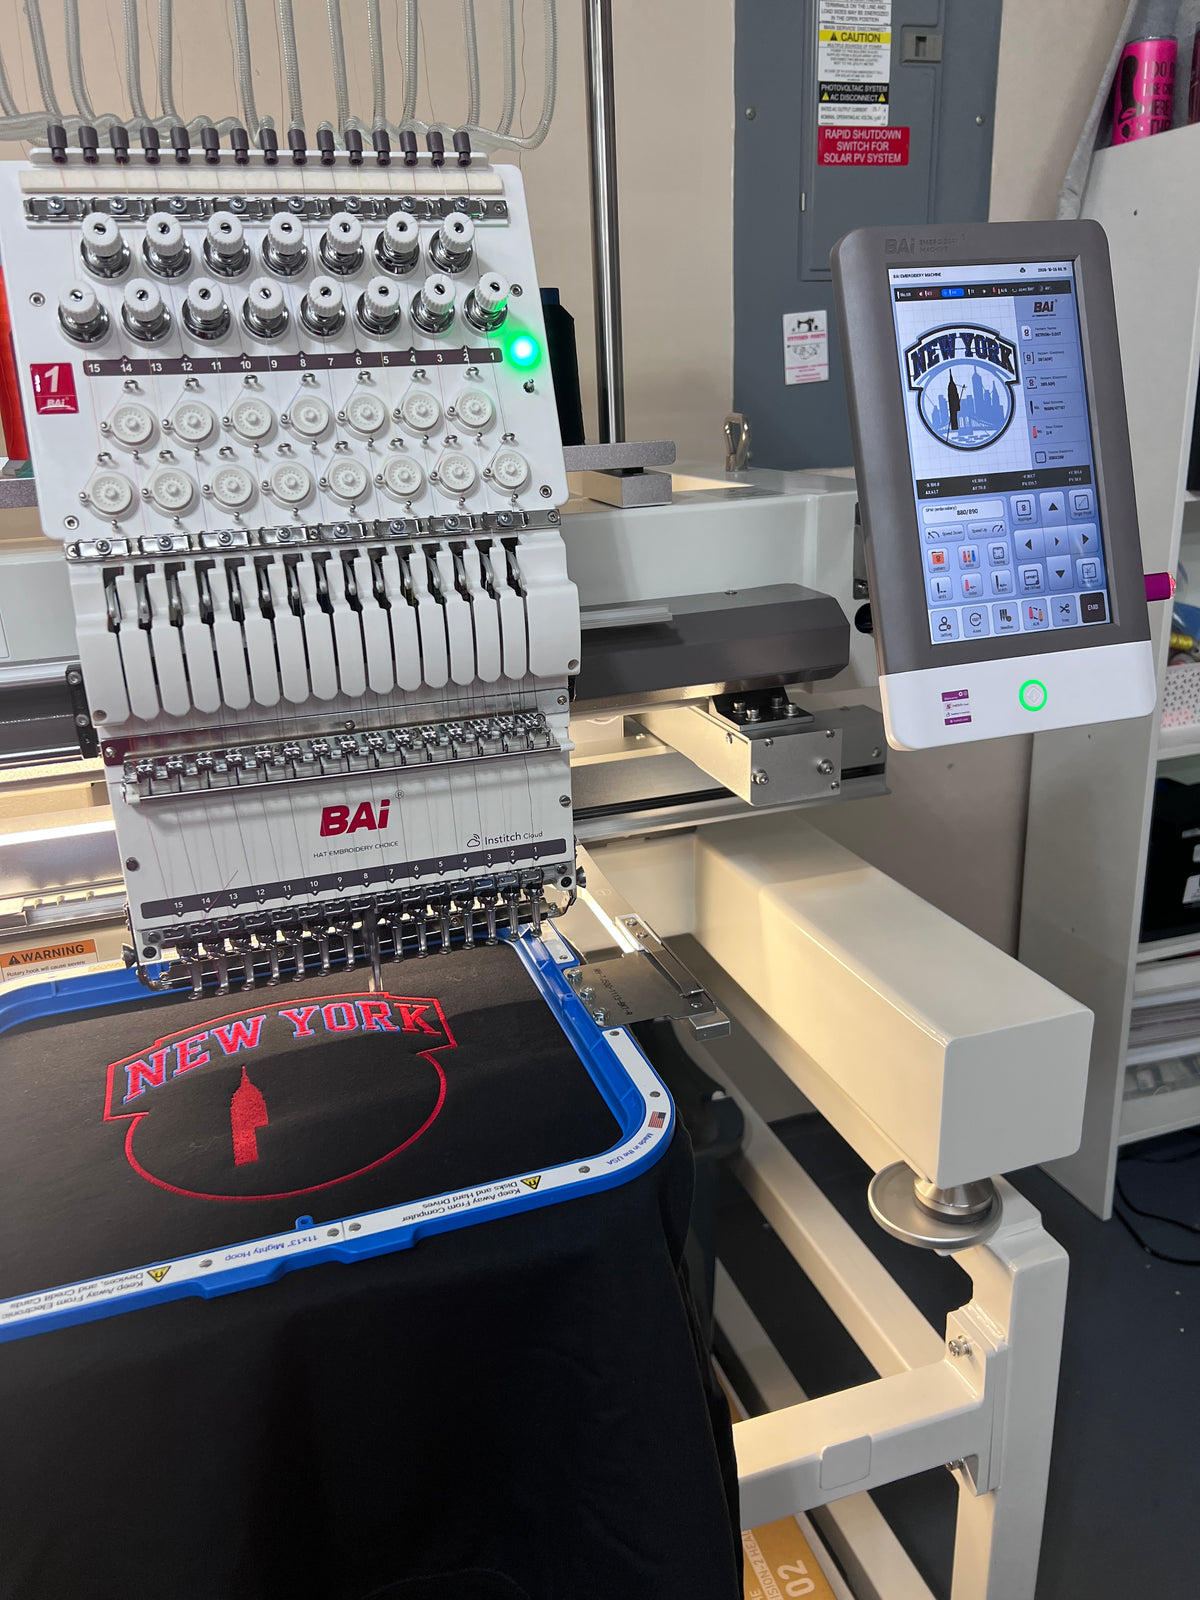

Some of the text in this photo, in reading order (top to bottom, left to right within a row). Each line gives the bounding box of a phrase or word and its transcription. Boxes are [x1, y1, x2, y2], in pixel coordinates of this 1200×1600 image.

[840, 32, 881, 43] CAUTION
[821, 84, 864, 92] PHOTOVOLTAIC
[840, 94, 878, 102] DISCONNECT
[825, 129, 902, 139] RAPID SHUTDOWN
[836, 141, 889, 151] SWITCH FOR
[823, 153, 901, 163] SOLAR PV SYSTEM
[1034, 301, 1054, 313] BAi
[88, 352, 495, 373] 15 14 13 12 11 10 9 8 7 6 5 4 3 2 1
[910, 332, 1015, 382] NEW YORK
[44, 365, 59, 393] 1
[956, 508, 979, 516] 880/890
[1087, 603, 1099, 611] EMB
[319, 799, 391, 837] BAi
[484, 831, 543, 846] Institch Cloud
[313, 840, 399, 859] HAT EMBROIDERY CHOICE
[174, 901, 183, 909] 15
[201, 897, 211, 905] 14
[229, 893, 238, 901] 13
[256, 888, 266, 896] 12
[283, 884, 292, 892] 11
[310, 880, 319, 888] 10
[337, 876, 343, 884] 9
[389, 868, 394, 876] 7
[21, 944, 85, 963] WARNING
[7, 970, 25, 978] Rotary
[67, 960, 86, 968] severe
[123, 1000, 442, 1105] NEW YORK
[638, 1132, 654, 1146] Made
[606, 1155, 624, 1165] USA
[623, 1149, 635, 1157] the
[422, 1181, 518, 1209] Disks and Hard Drives
[402, 1188, 521, 1222] Keep Away From Computer
[253, 1242, 285, 1254] Mighty
[225, 1251, 251, 1261] Hoop
[10, 1272, 144, 1309] Devices, and Credit Cards
[1, 1281, 144, 1320] Keep Away From Electronic
[777, 1560, 815, 1597] 02
